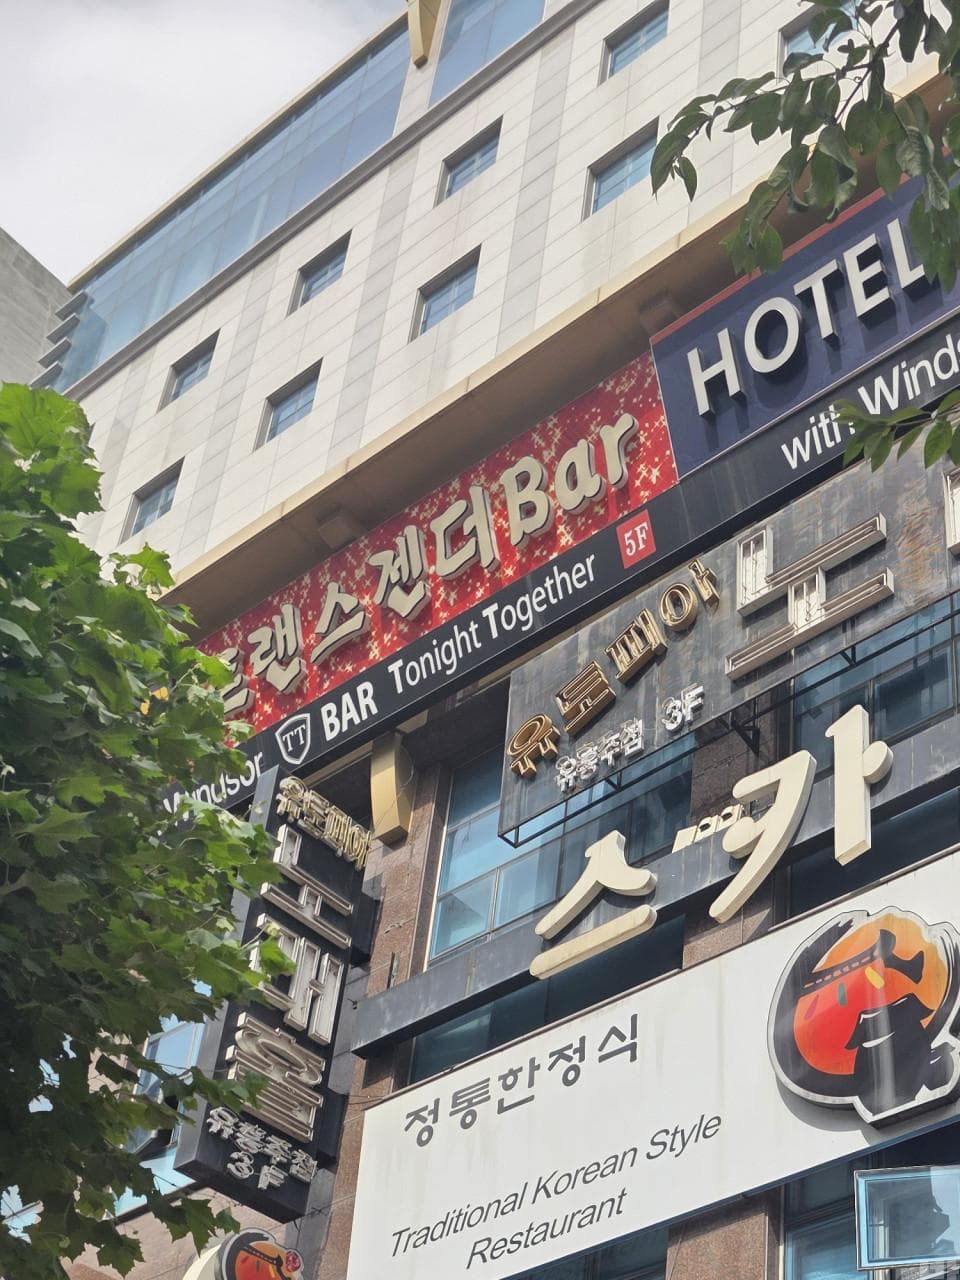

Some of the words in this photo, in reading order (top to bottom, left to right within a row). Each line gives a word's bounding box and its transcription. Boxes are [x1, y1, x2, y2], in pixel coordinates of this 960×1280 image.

[686, 215, 927, 420] HOTEL
[780, 402, 857, 470] with
[623, 524, 650, 557] 5F
[320, 681, 378, 742] BAR
[387, 621, 482, 695] Tonight
[482, 553, 596, 640] Together
[507, 559, 720, 778] 유토피아
[555, 717, 645, 793] 유흥주점
[662, 682, 704, 732] 3F
[404, 1013, 639, 1148] 정통한정식
[227, 1150, 288, 1192] 3F
[390, 1182, 527, 1258] Traditional
[531, 1146, 638, 1206] Korean
[645, 1113, 723, 1163] Style
[466, 1188, 628, 1270] Restaurant
